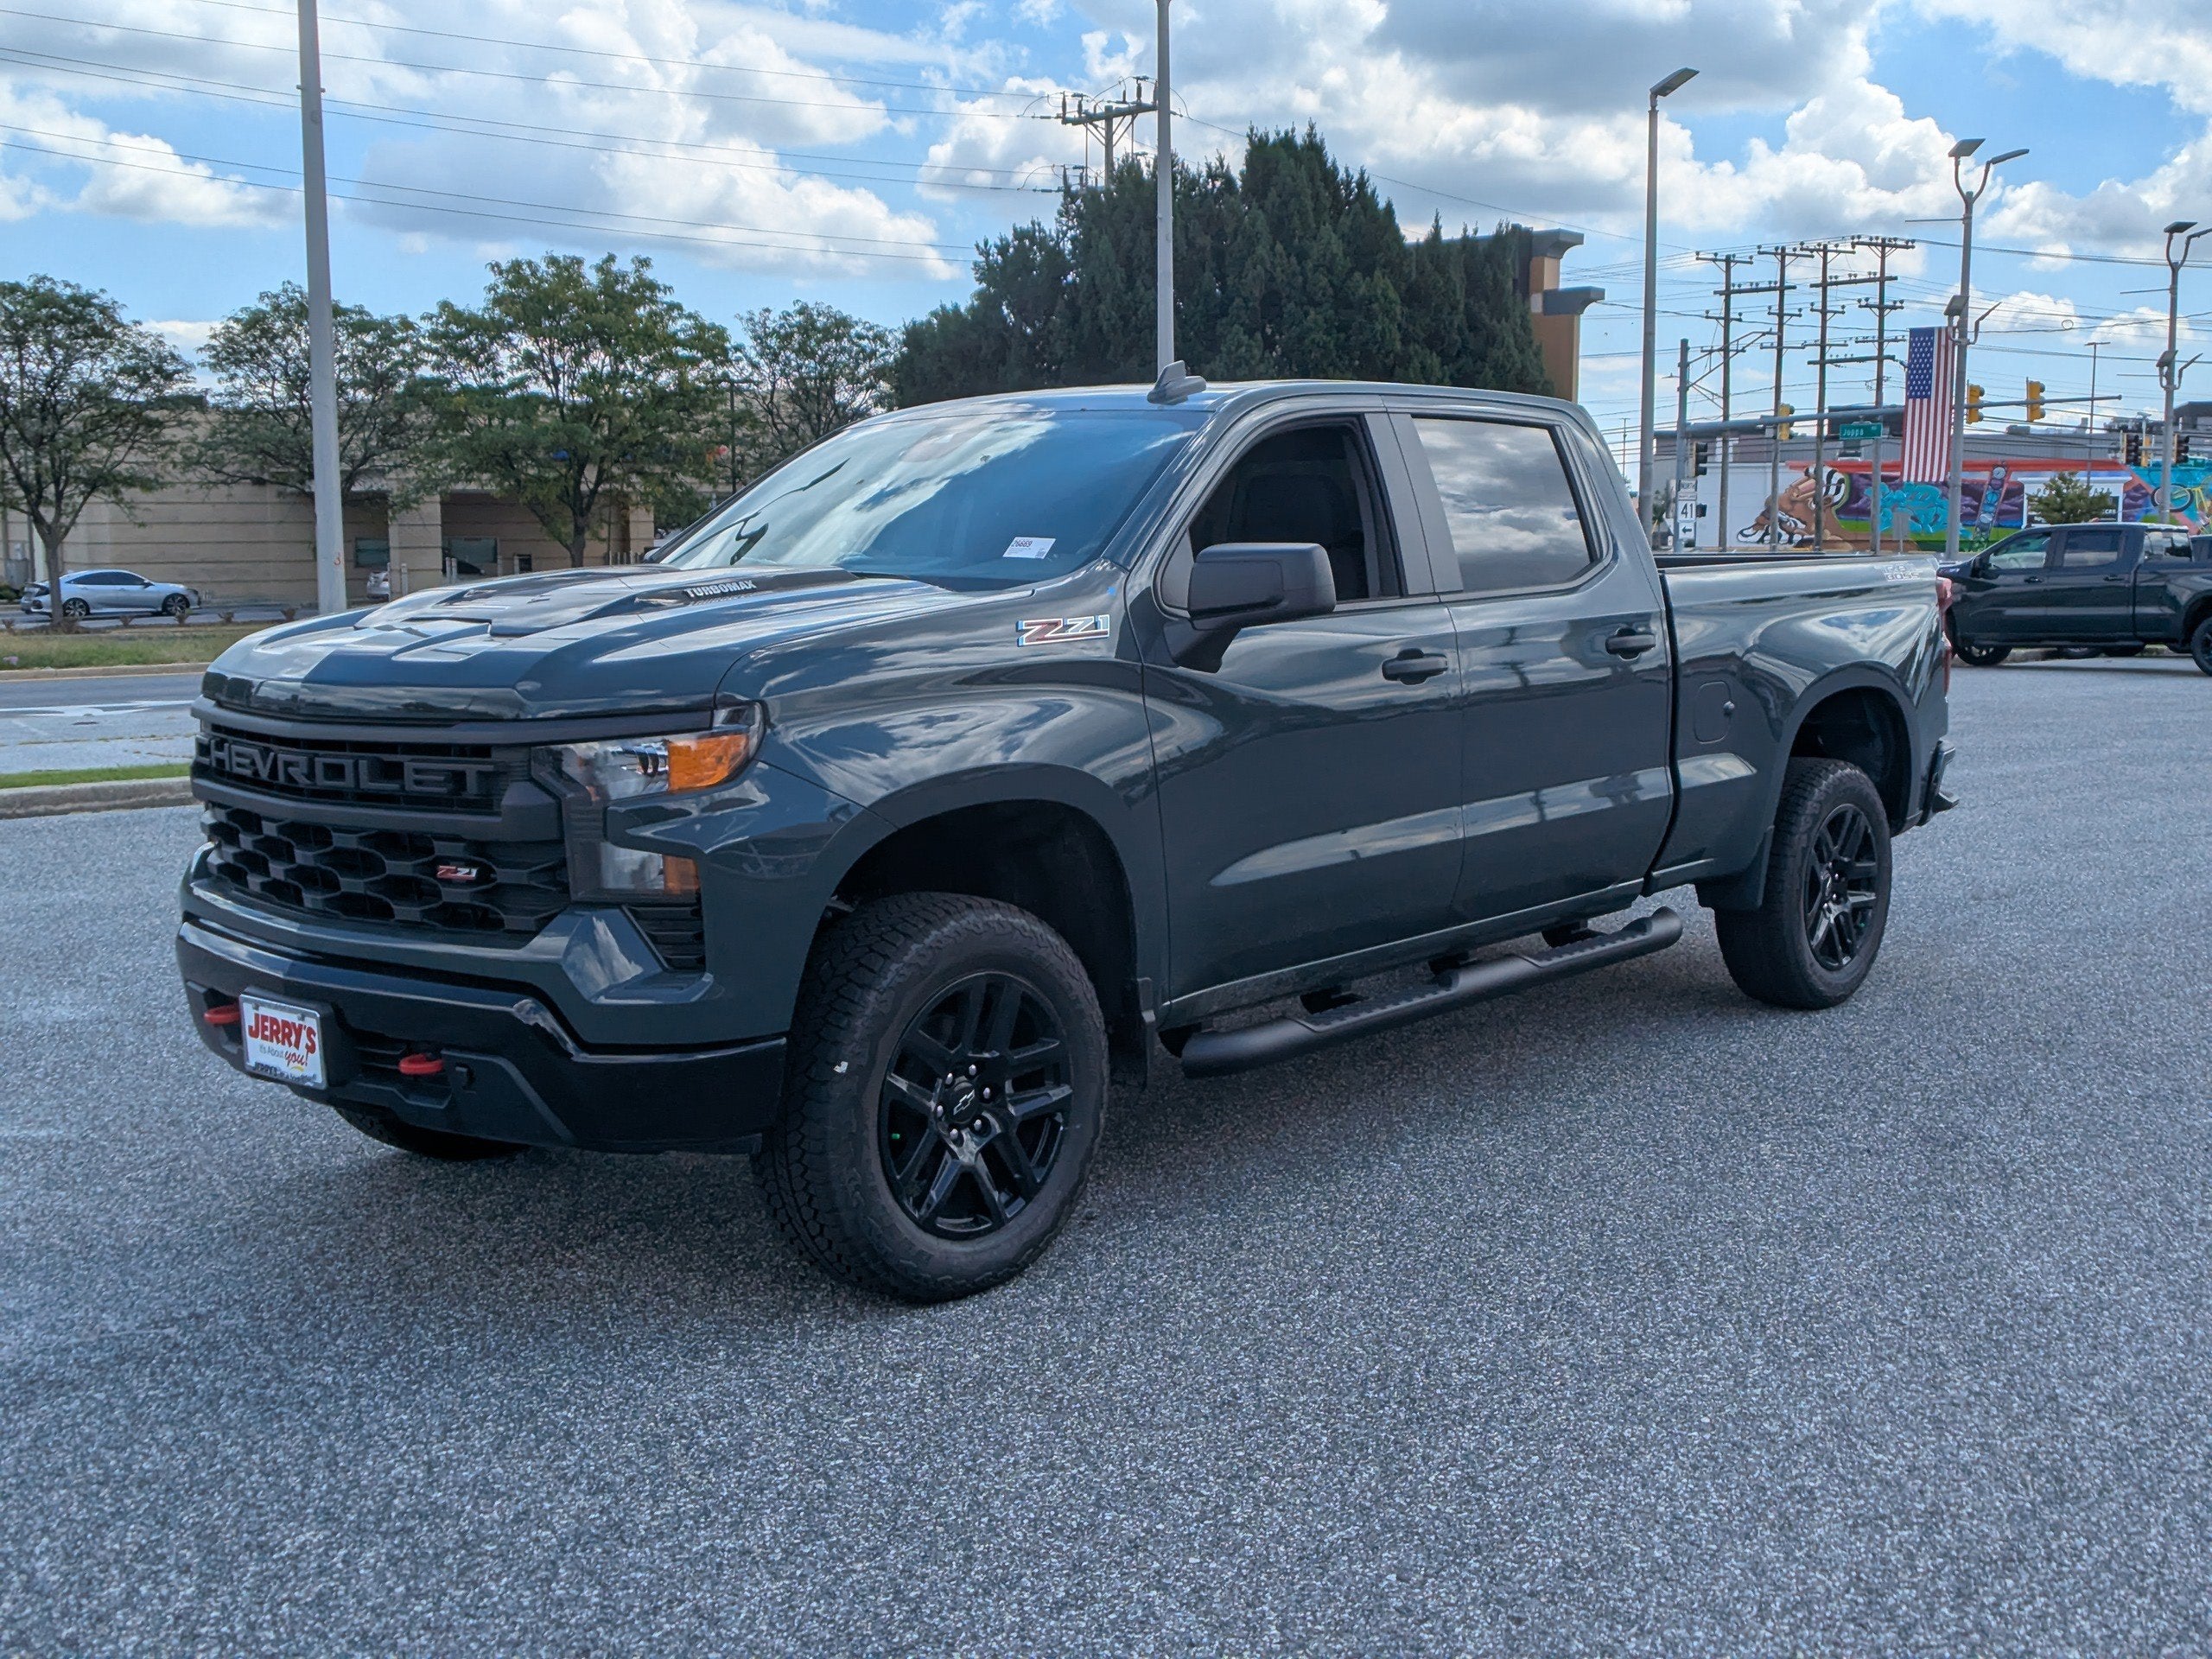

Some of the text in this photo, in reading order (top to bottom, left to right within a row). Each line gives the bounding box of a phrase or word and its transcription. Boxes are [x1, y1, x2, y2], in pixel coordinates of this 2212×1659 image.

[1842, 429, 1864, 437] Joppa
[1681, 503, 1694, 518] 41
[683, 580, 757, 598] TURBOMAX
[1016, 613, 1110, 647] Z71
[194, 734, 496, 795] CHEVROLET
[436, 865, 477, 880] Z71
[248, 1012, 317, 1054] JERRY'S
[284, 1051, 308, 1068] you!
